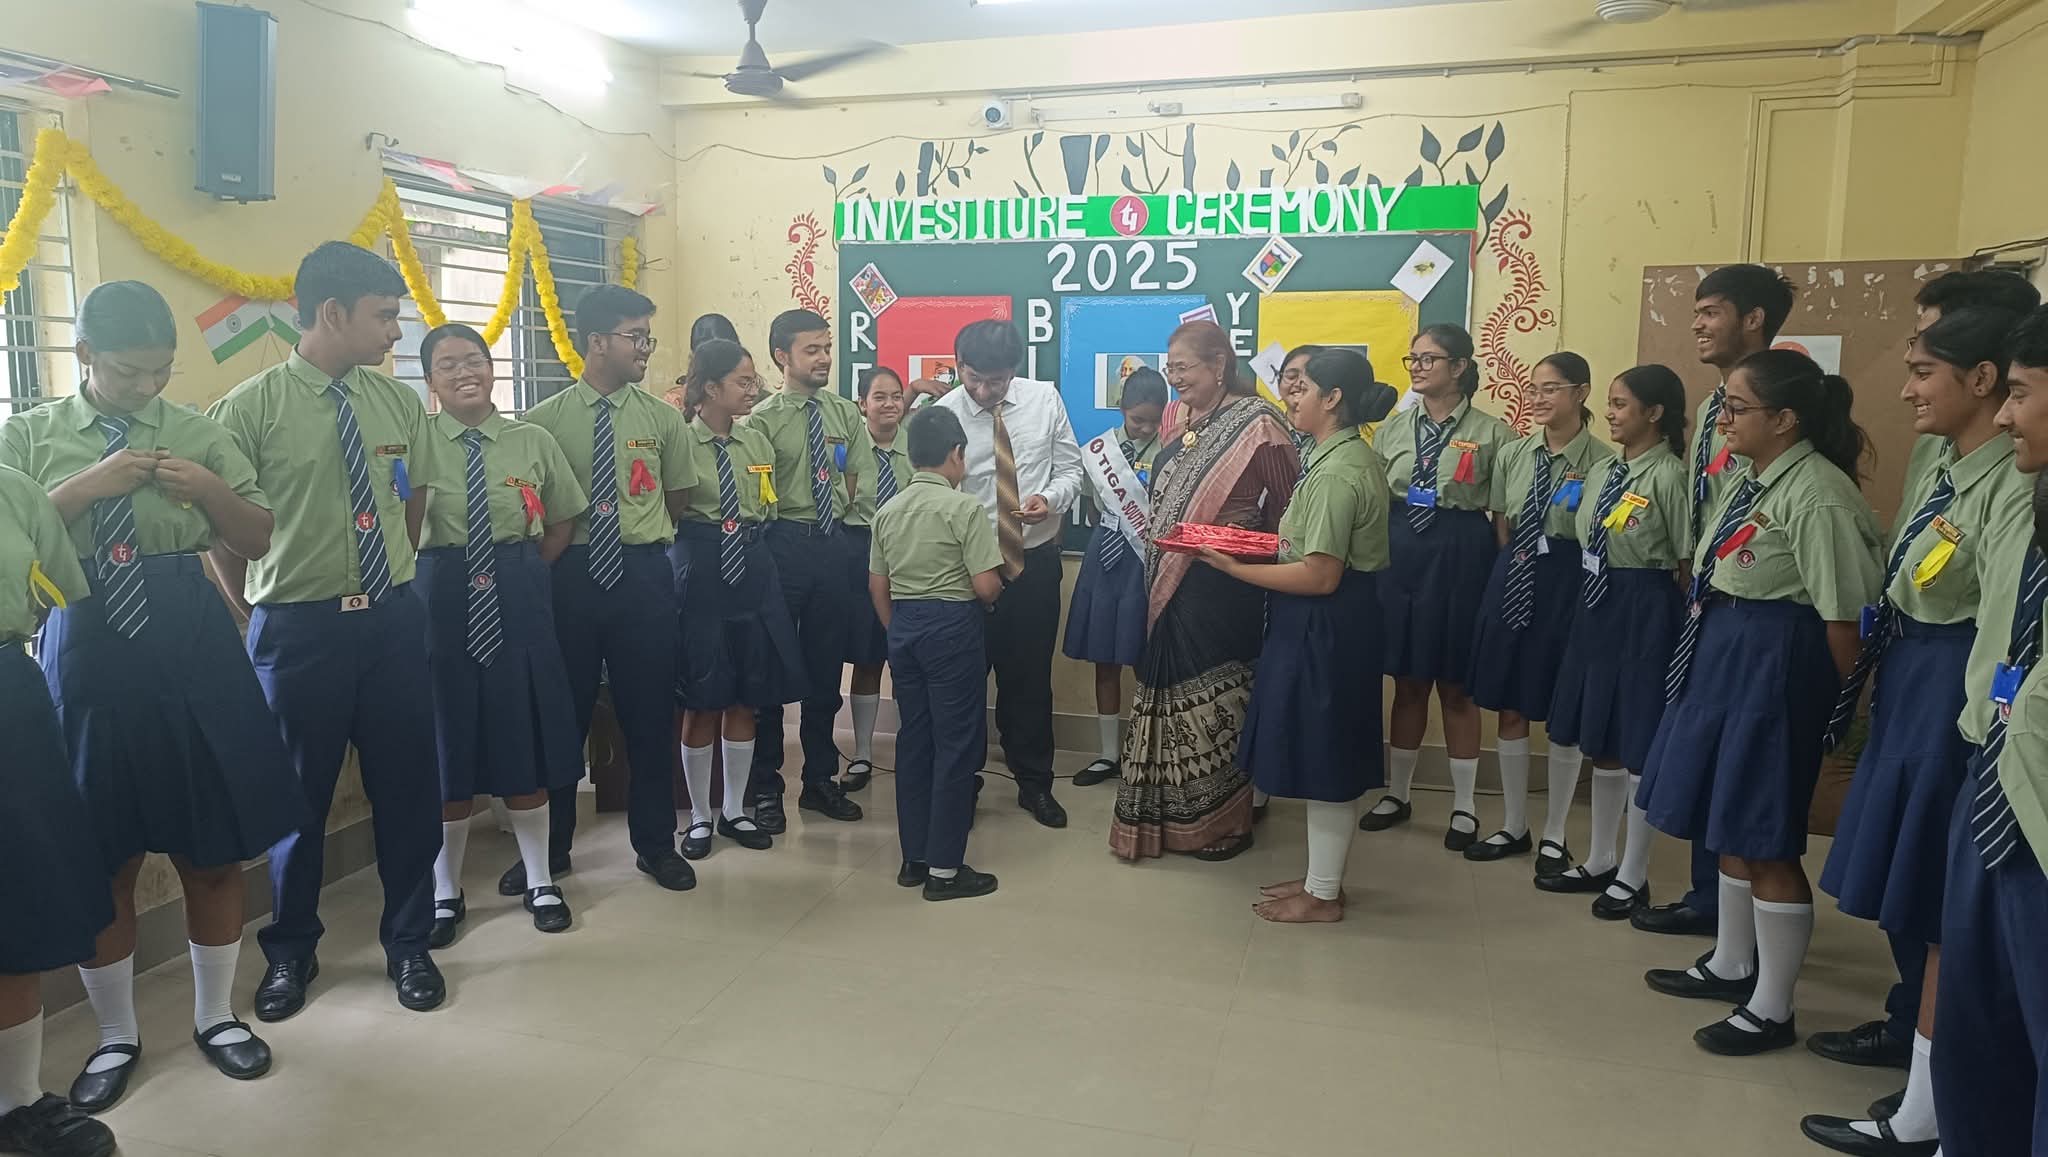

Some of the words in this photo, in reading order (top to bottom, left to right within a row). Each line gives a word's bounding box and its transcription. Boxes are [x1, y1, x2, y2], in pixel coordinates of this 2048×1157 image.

[841, 195, 1088, 240] INVESTITURE
[1166, 183, 1407, 236] CEREMONY
[1047, 241, 1198, 292] 2025
[1098, 453, 1127, 502] TIGA
[1121, 500, 1146, 530] SOUTH
